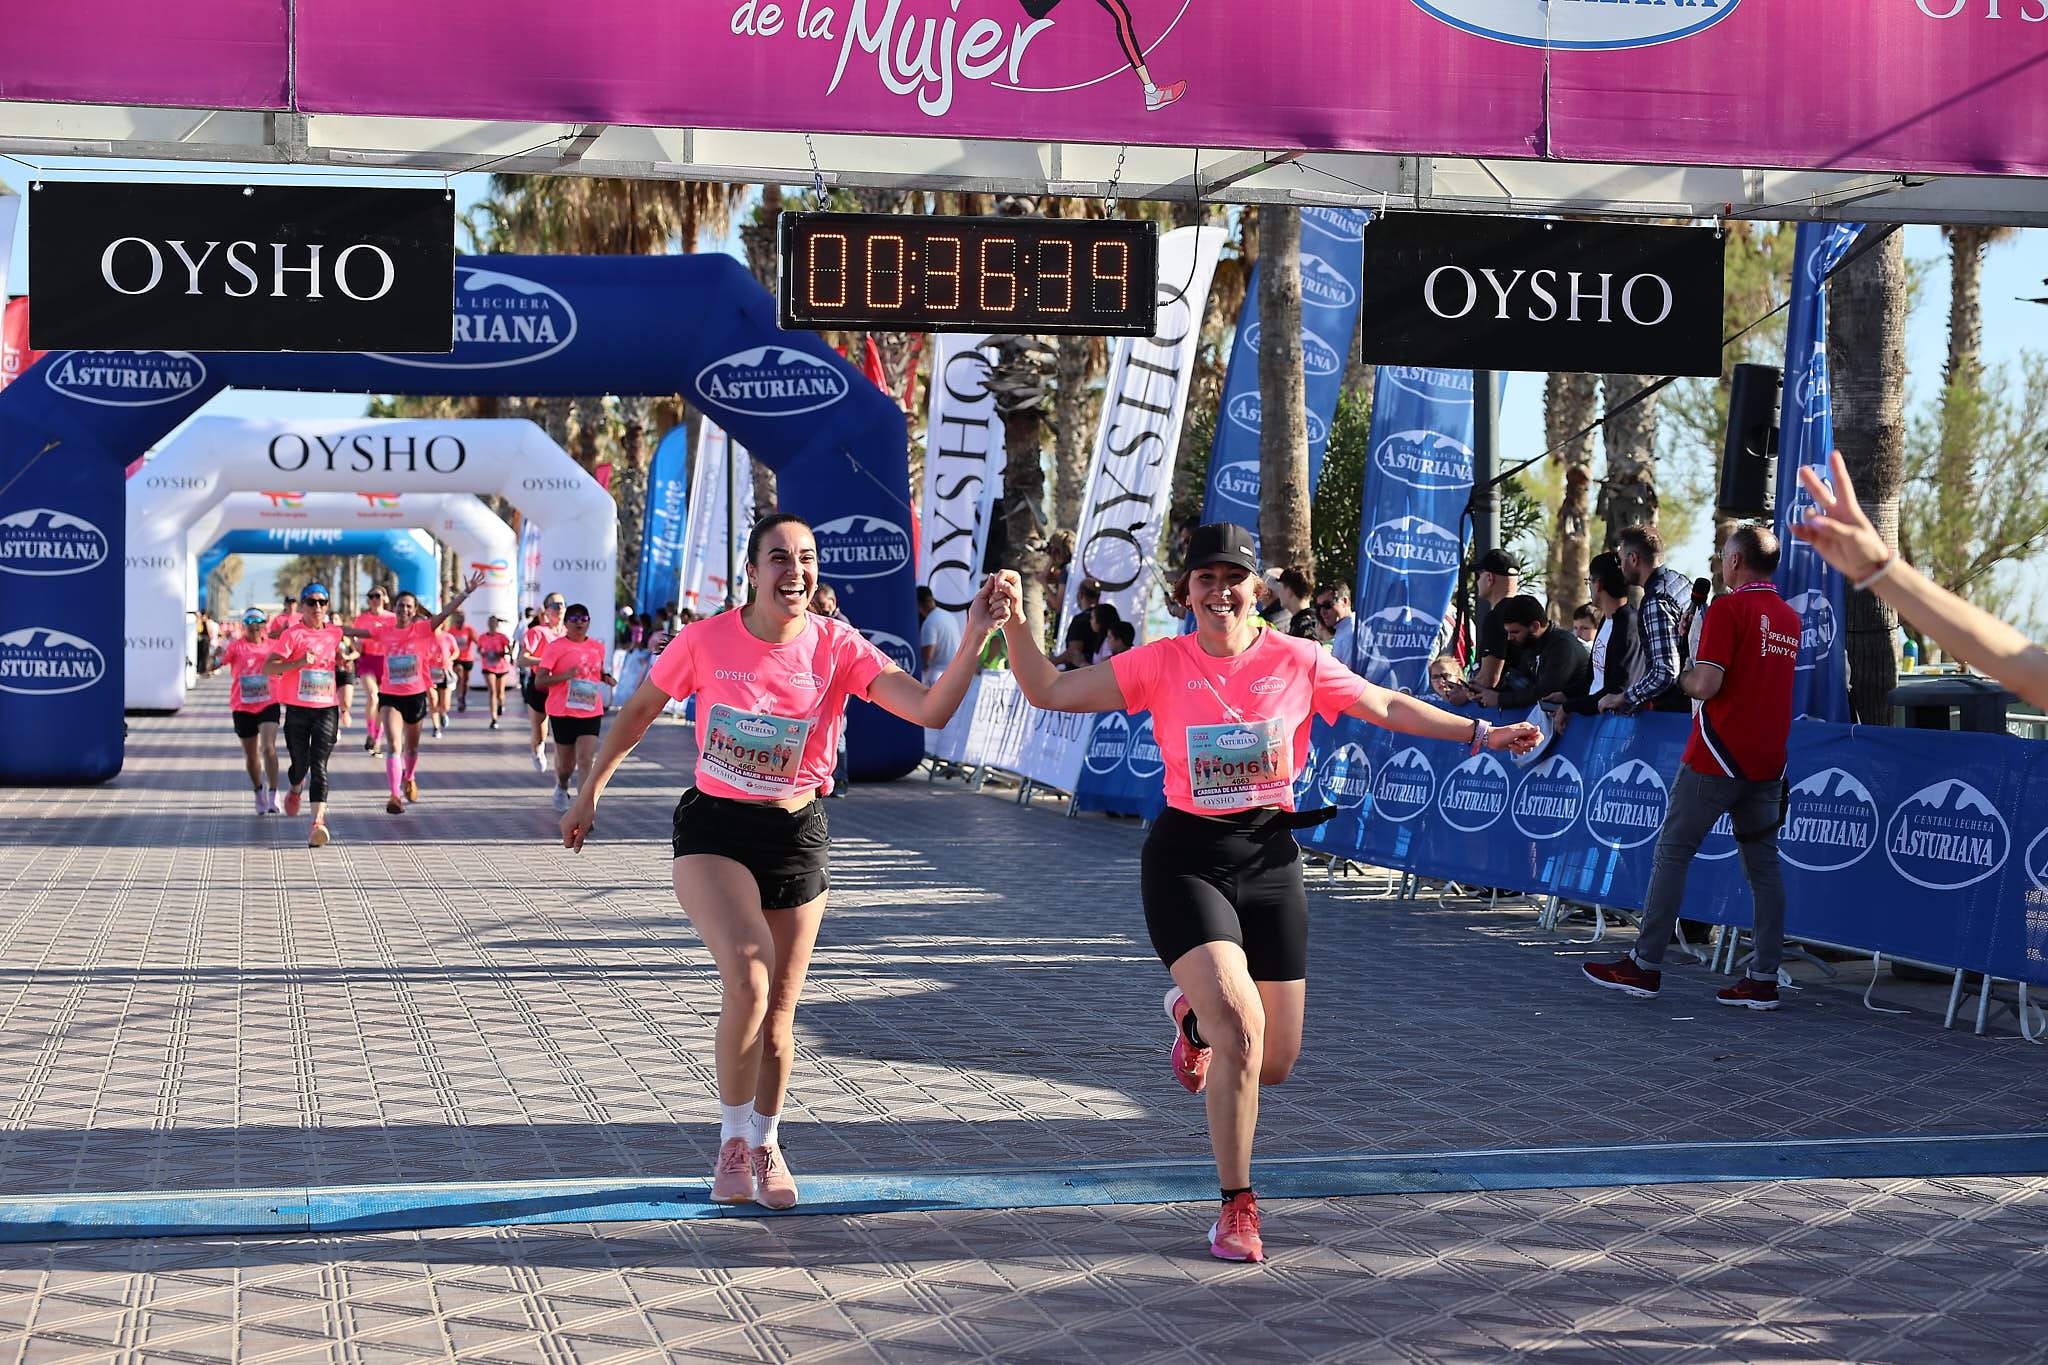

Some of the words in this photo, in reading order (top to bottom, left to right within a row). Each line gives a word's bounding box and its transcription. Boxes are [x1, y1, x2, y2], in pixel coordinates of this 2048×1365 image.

[731, 0, 785, 36] de
[797, 0, 836, 40] la
[825, 0, 1057, 117] Mujer
[101, 235, 396, 302] OYSHO
[471, 297, 550, 309] LECHERA
[1423, 264, 1674, 327] OYSHO
[454, 314, 558, 344] RIANA
[55, 358, 194, 389] ASTURIANA
[709, 373, 840, 400] ASTURIANA
[267, 432, 467, 474] OYSHO
[1382, 444, 1473, 482] ASTURIANA
[146, 476, 207, 489] OYSHO
[522, 478, 581, 490] OYSHO
[552, 558, 607, 573] OYSHO
[820, 543, 906, 564] STURIANA
[1768, 644, 1790, 656] TONY
[0, 659, 97, 678] STURIANA
[715, 669, 757, 682] OYSHO
[733, 745, 770, 764] 016
[1222, 761, 1260, 776] 016
[1203, 796, 1235, 806] OYSHO
[1375, 772, 1427, 805] ASTURIANA
[1441, 779, 1502, 813] ASTURIANA
[1515, 784, 1577, 820] ASTURIANA
[1589, 788, 1661, 828] ASTURIANA
[1798, 802, 1833, 813] CENTRAL
[1834, 805, 1870, 817] LECHERA
[1777, 803, 1869, 849] ASTURIANA
[1914, 814, 1952, 827] CENTRAL
[1954, 817, 1995, 833] LECHERA
[1891, 814, 1994, 867] ASTURIANA
